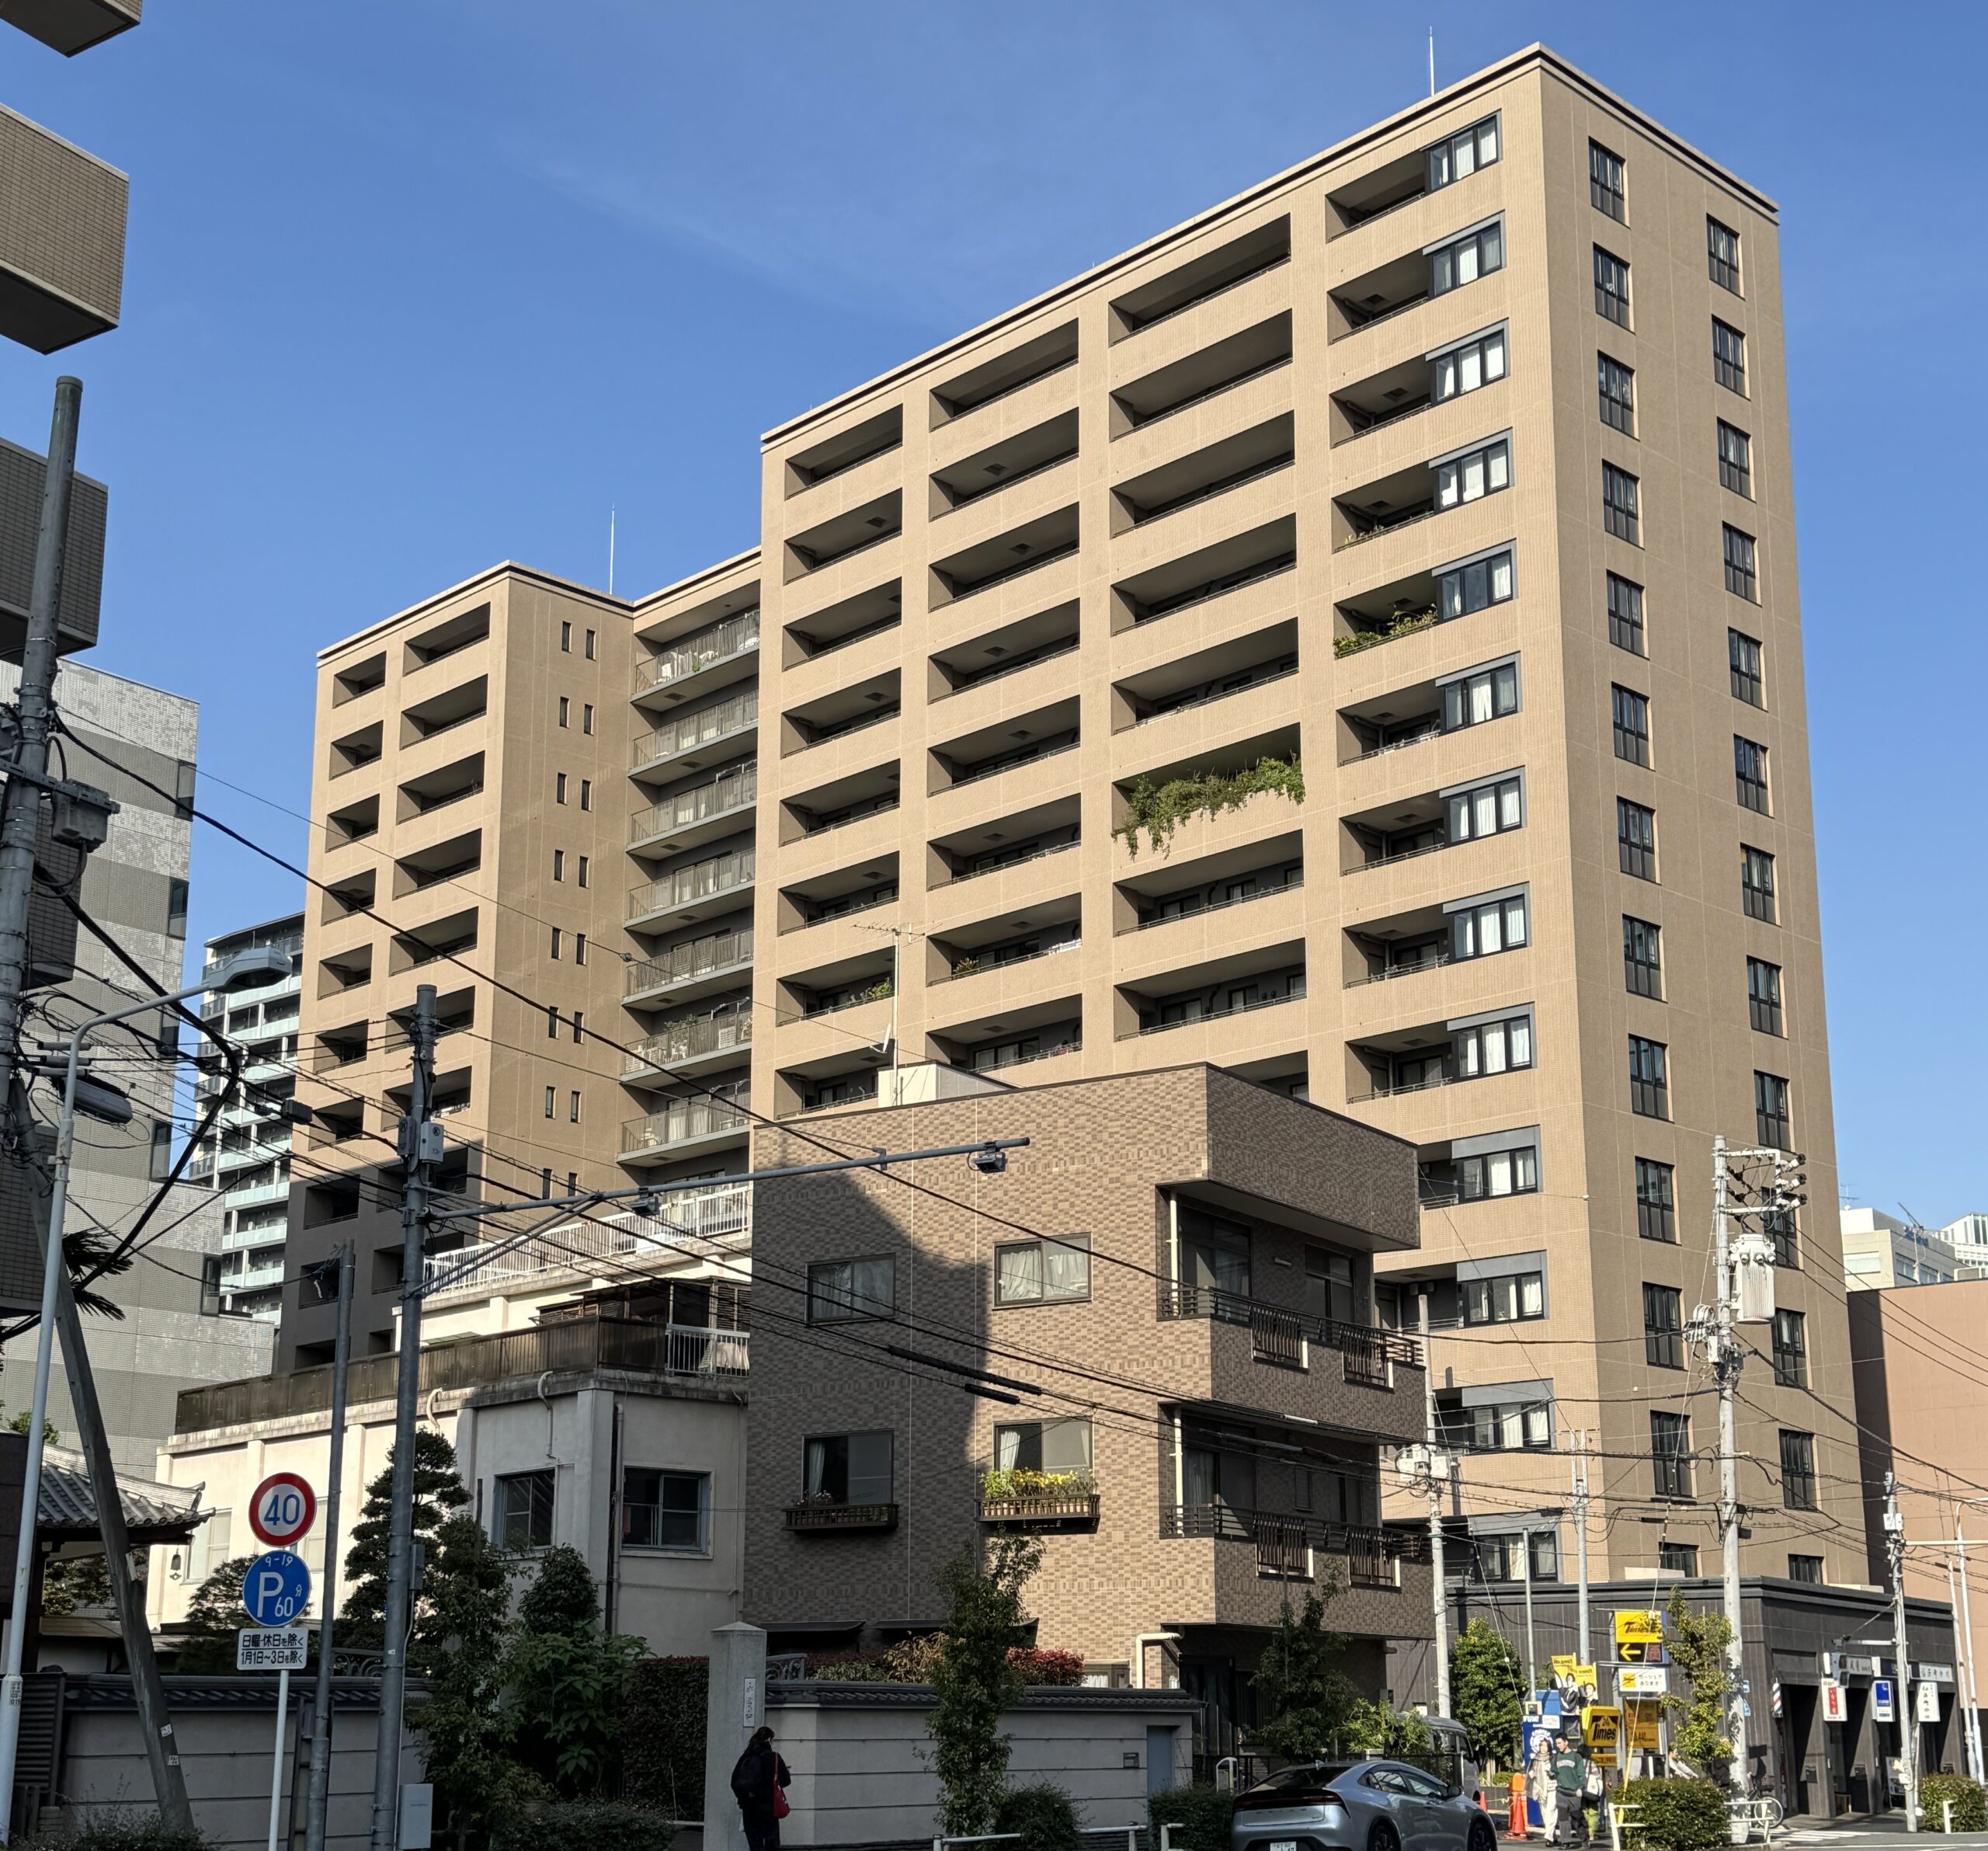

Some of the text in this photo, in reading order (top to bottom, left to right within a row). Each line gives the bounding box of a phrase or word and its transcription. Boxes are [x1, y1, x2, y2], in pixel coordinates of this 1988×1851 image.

[264, 1494, 300, 1526] 40
[265, 1554, 293, 1567] 9-19
[257, 1571, 283, 1617] P
[294, 1584, 303, 1597] 分
[274, 1596, 294, 1617] 60
